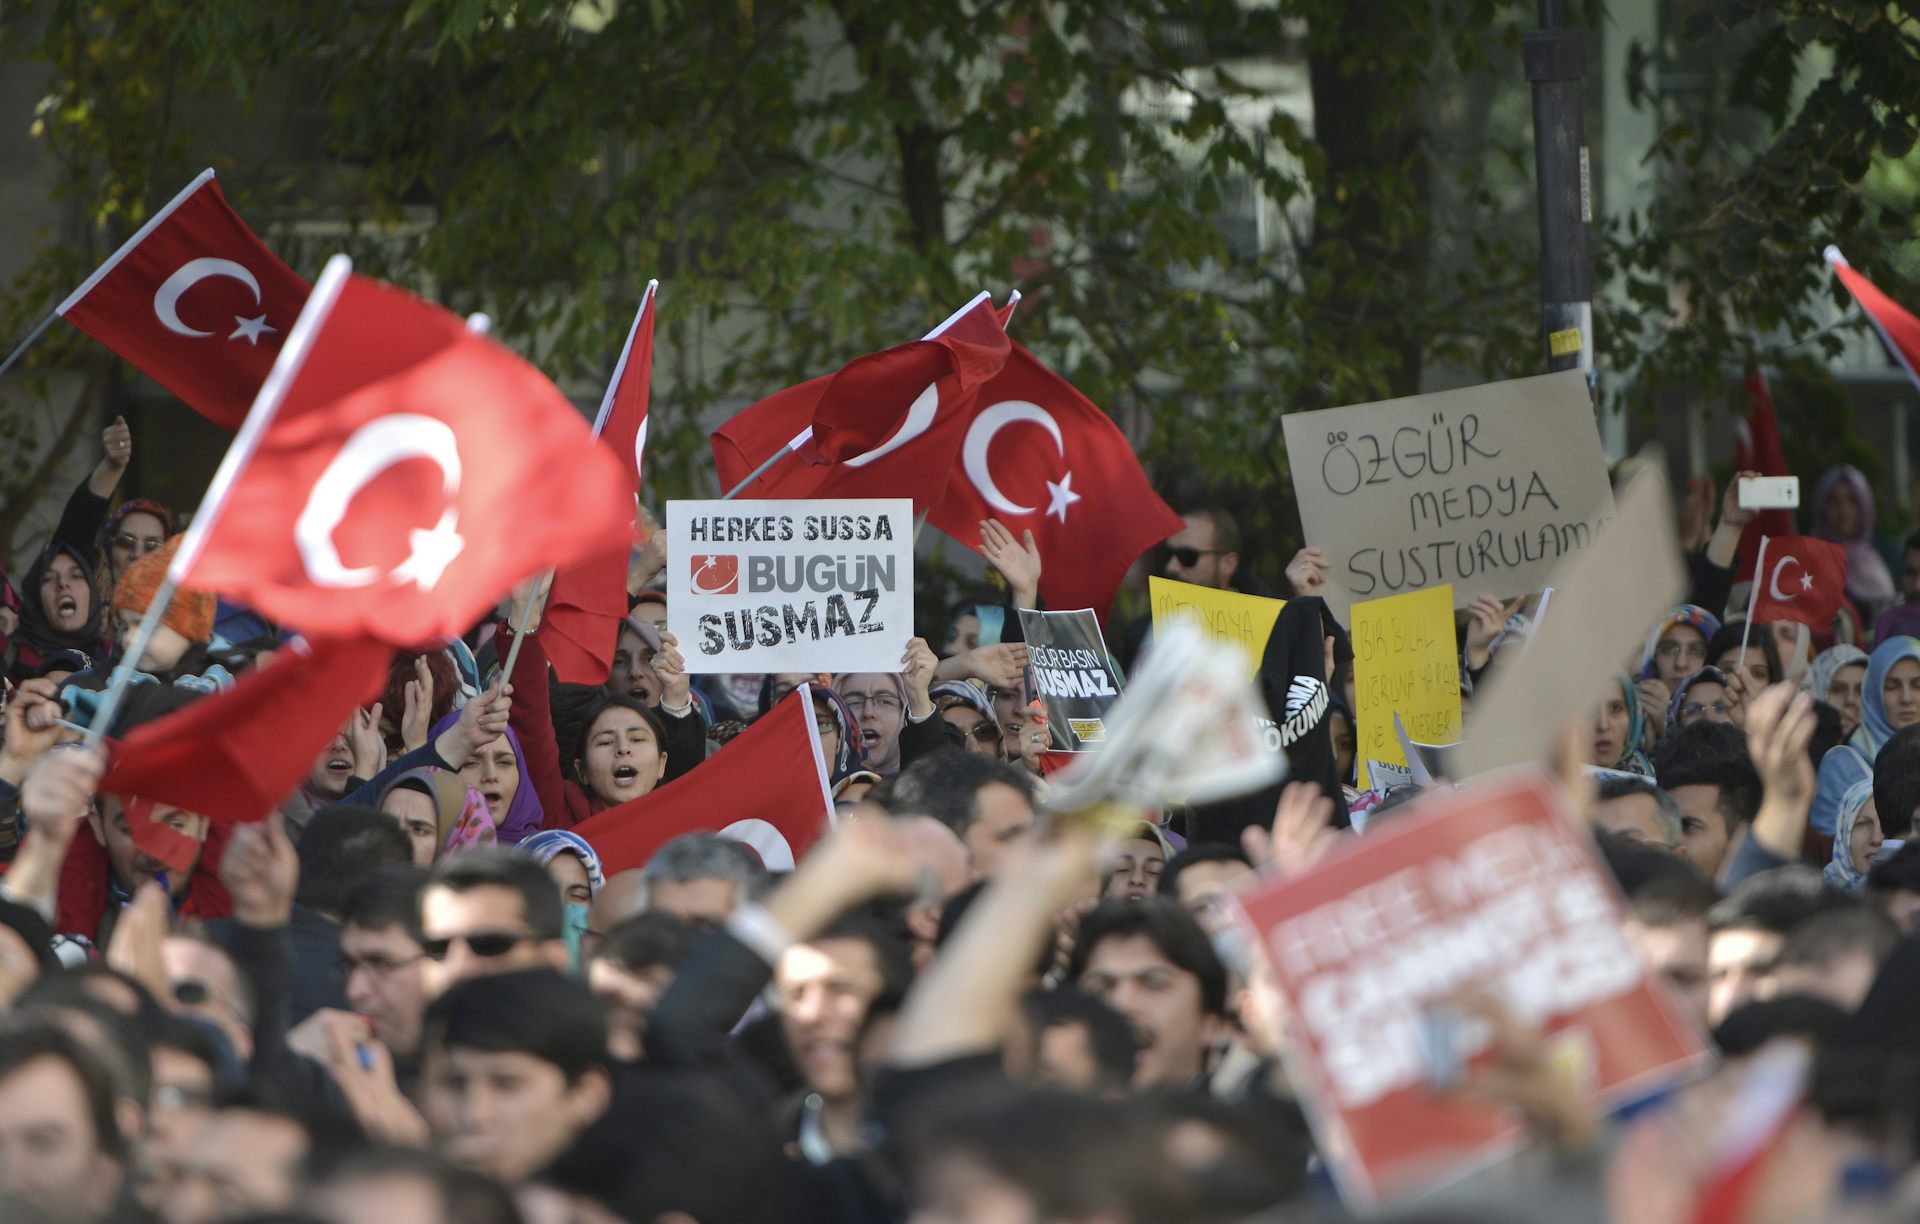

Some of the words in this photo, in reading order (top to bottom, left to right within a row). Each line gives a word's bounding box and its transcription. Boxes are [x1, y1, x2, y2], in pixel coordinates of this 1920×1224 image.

[1322, 412, 1501, 495] ÖZGÜR
[1410, 470, 1559, 531] MEDYA
[690, 516, 793, 542] HERKES
[803, 514, 893, 541] SUSSA
[748, 554, 896, 593] BUGÜN
[1349, 517, 1604, 595] SUSTURULAM
[698, 587, 885, 656] SUSMAZ
[1033, 665, 1118, 698] SUSMAZ
[1059, 649, 1102, 668] BASIN
